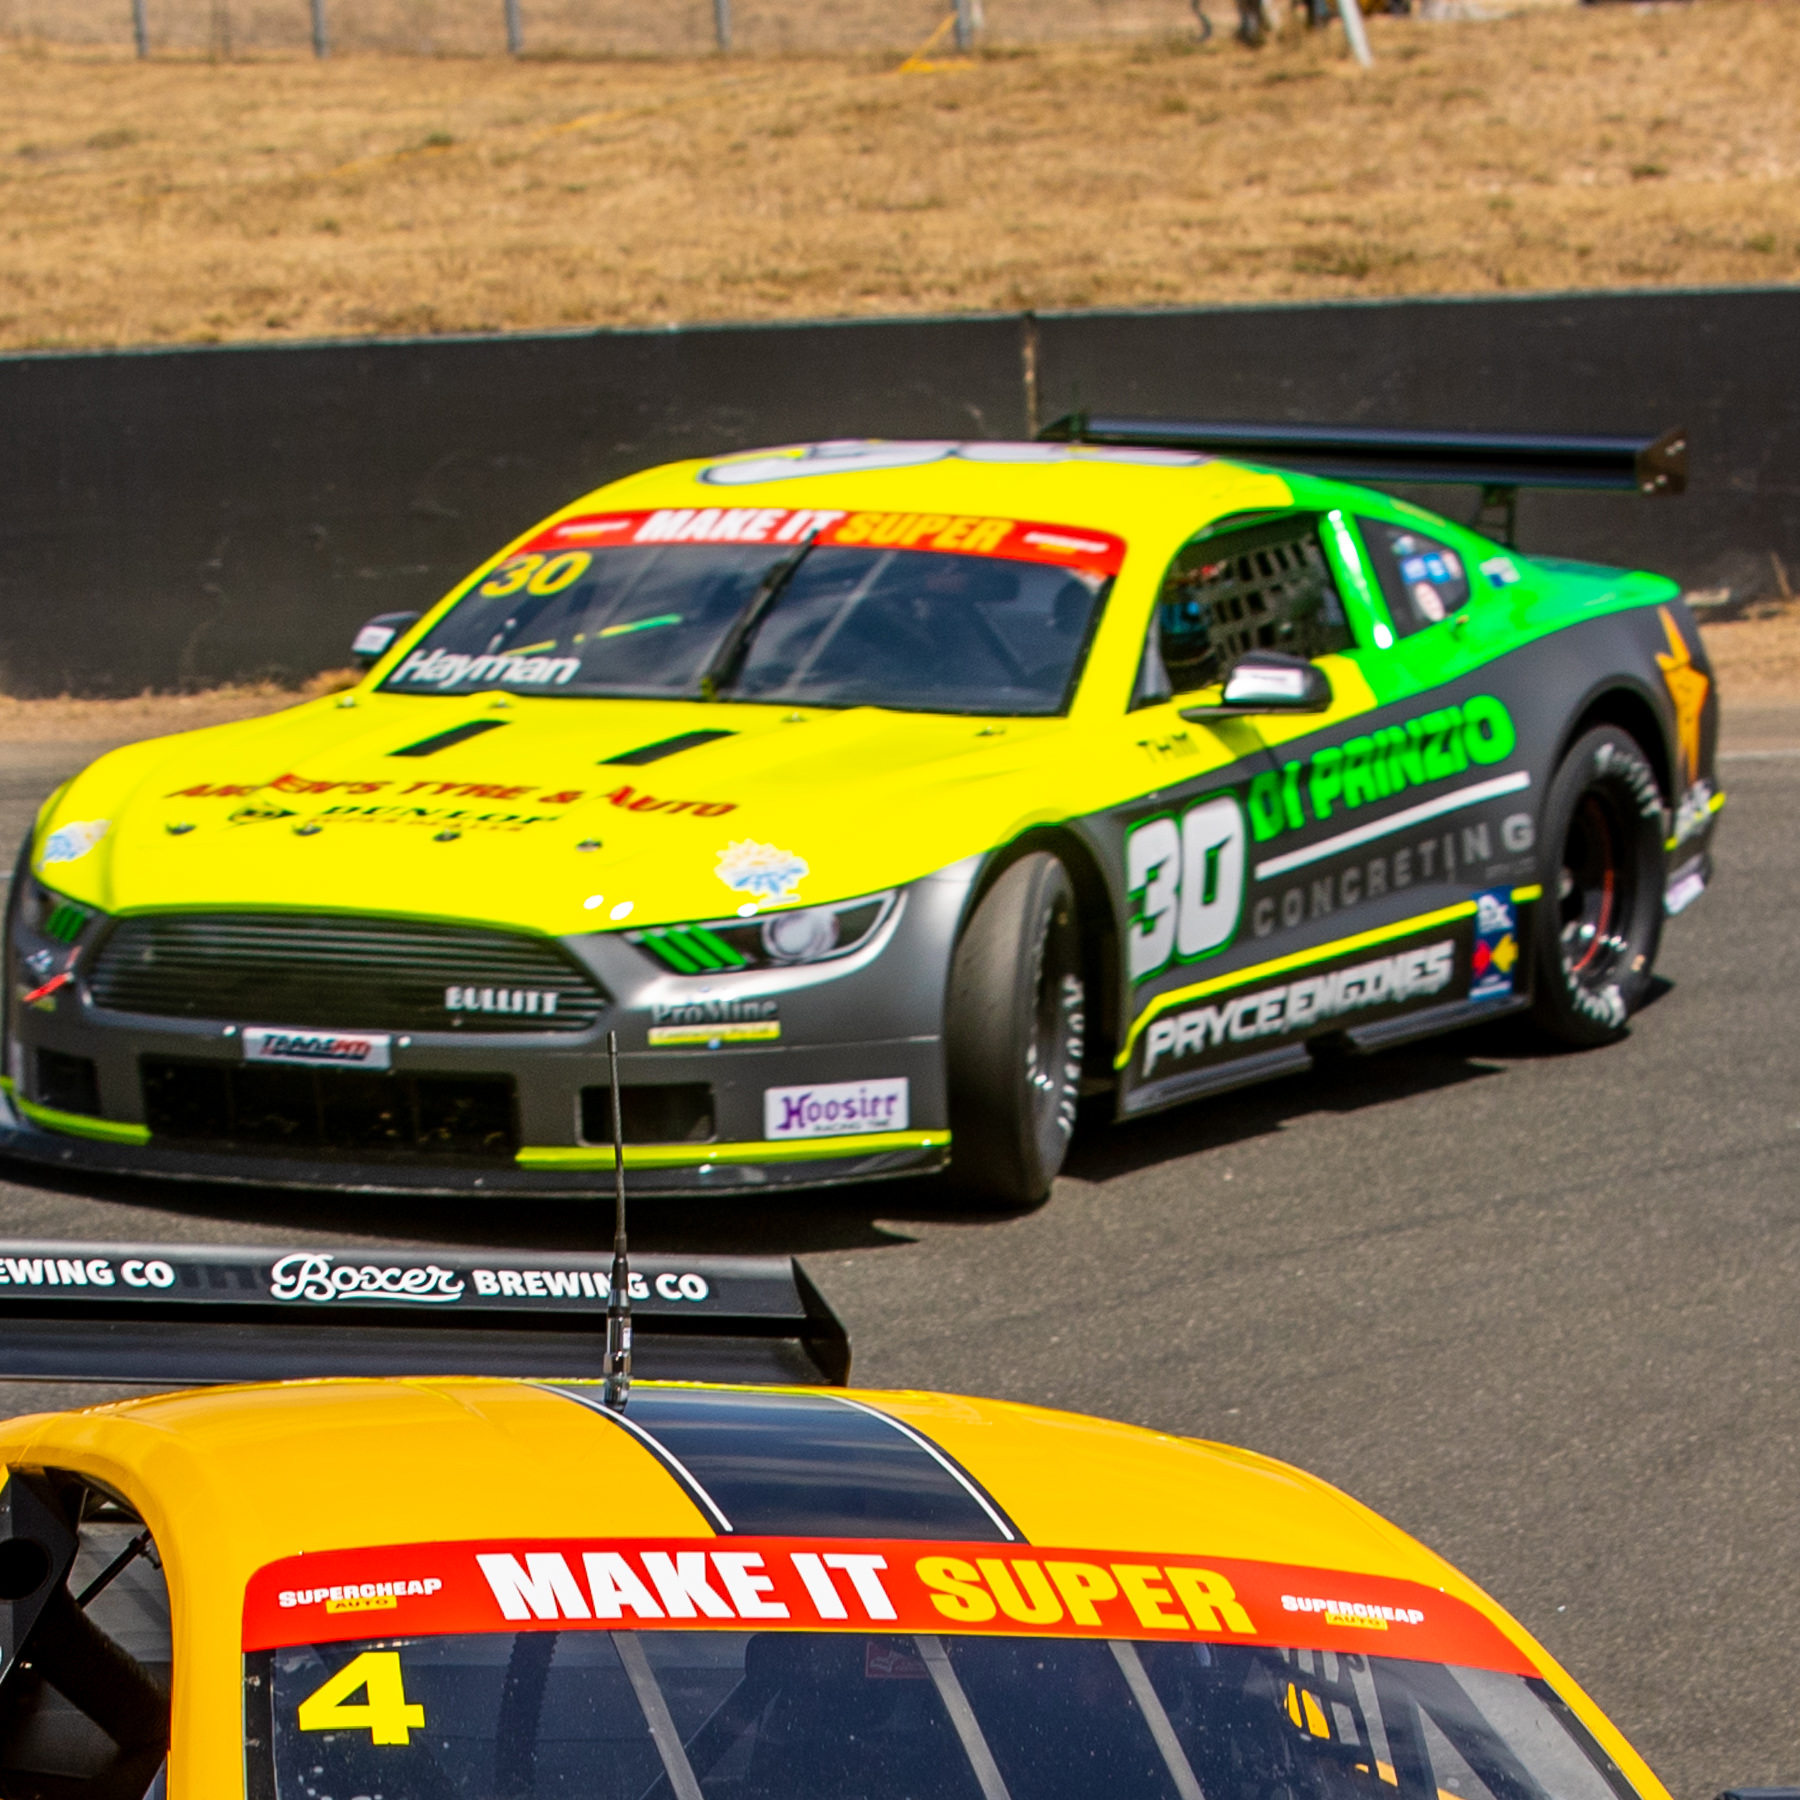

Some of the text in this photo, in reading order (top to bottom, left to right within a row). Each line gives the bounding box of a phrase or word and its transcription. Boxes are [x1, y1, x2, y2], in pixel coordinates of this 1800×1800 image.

[634, 509, 778, 542] MAKE
[775, 510, 847, 541] IT
[836, 512, 1016, 552] SUPER
[480, 551, 593, 598] 30
[390, 649, 581, 688] Hayman
[1248, 760, 1304, 842] DI
[1308, 694, 1516, 819] PRINZIO
[604, 785, 739, 818] AUTO
[1127, 792, 1246, 984] 30
[1253, 813, 1535, 937] CONCRETING
[1144, 985, 1290, 1077] PRYCE
[776, 1088, 898, 1130] Hoosier
[121, 1259, 176, 1288] CO
[271, 1253, 465, 1302] Boxer
[656, 1273, 709, 1300] CO
[278, 1578, 443, 1608] SUPERCHEAP
[334, 1597, 390, 1611] AUTO
[475, 1552, 1258, 1634] MAKE IT SUPER
[1281, 1595, 1424, 1625] SUPERCHEAP
[298, 1652, 425, 1745] 4
